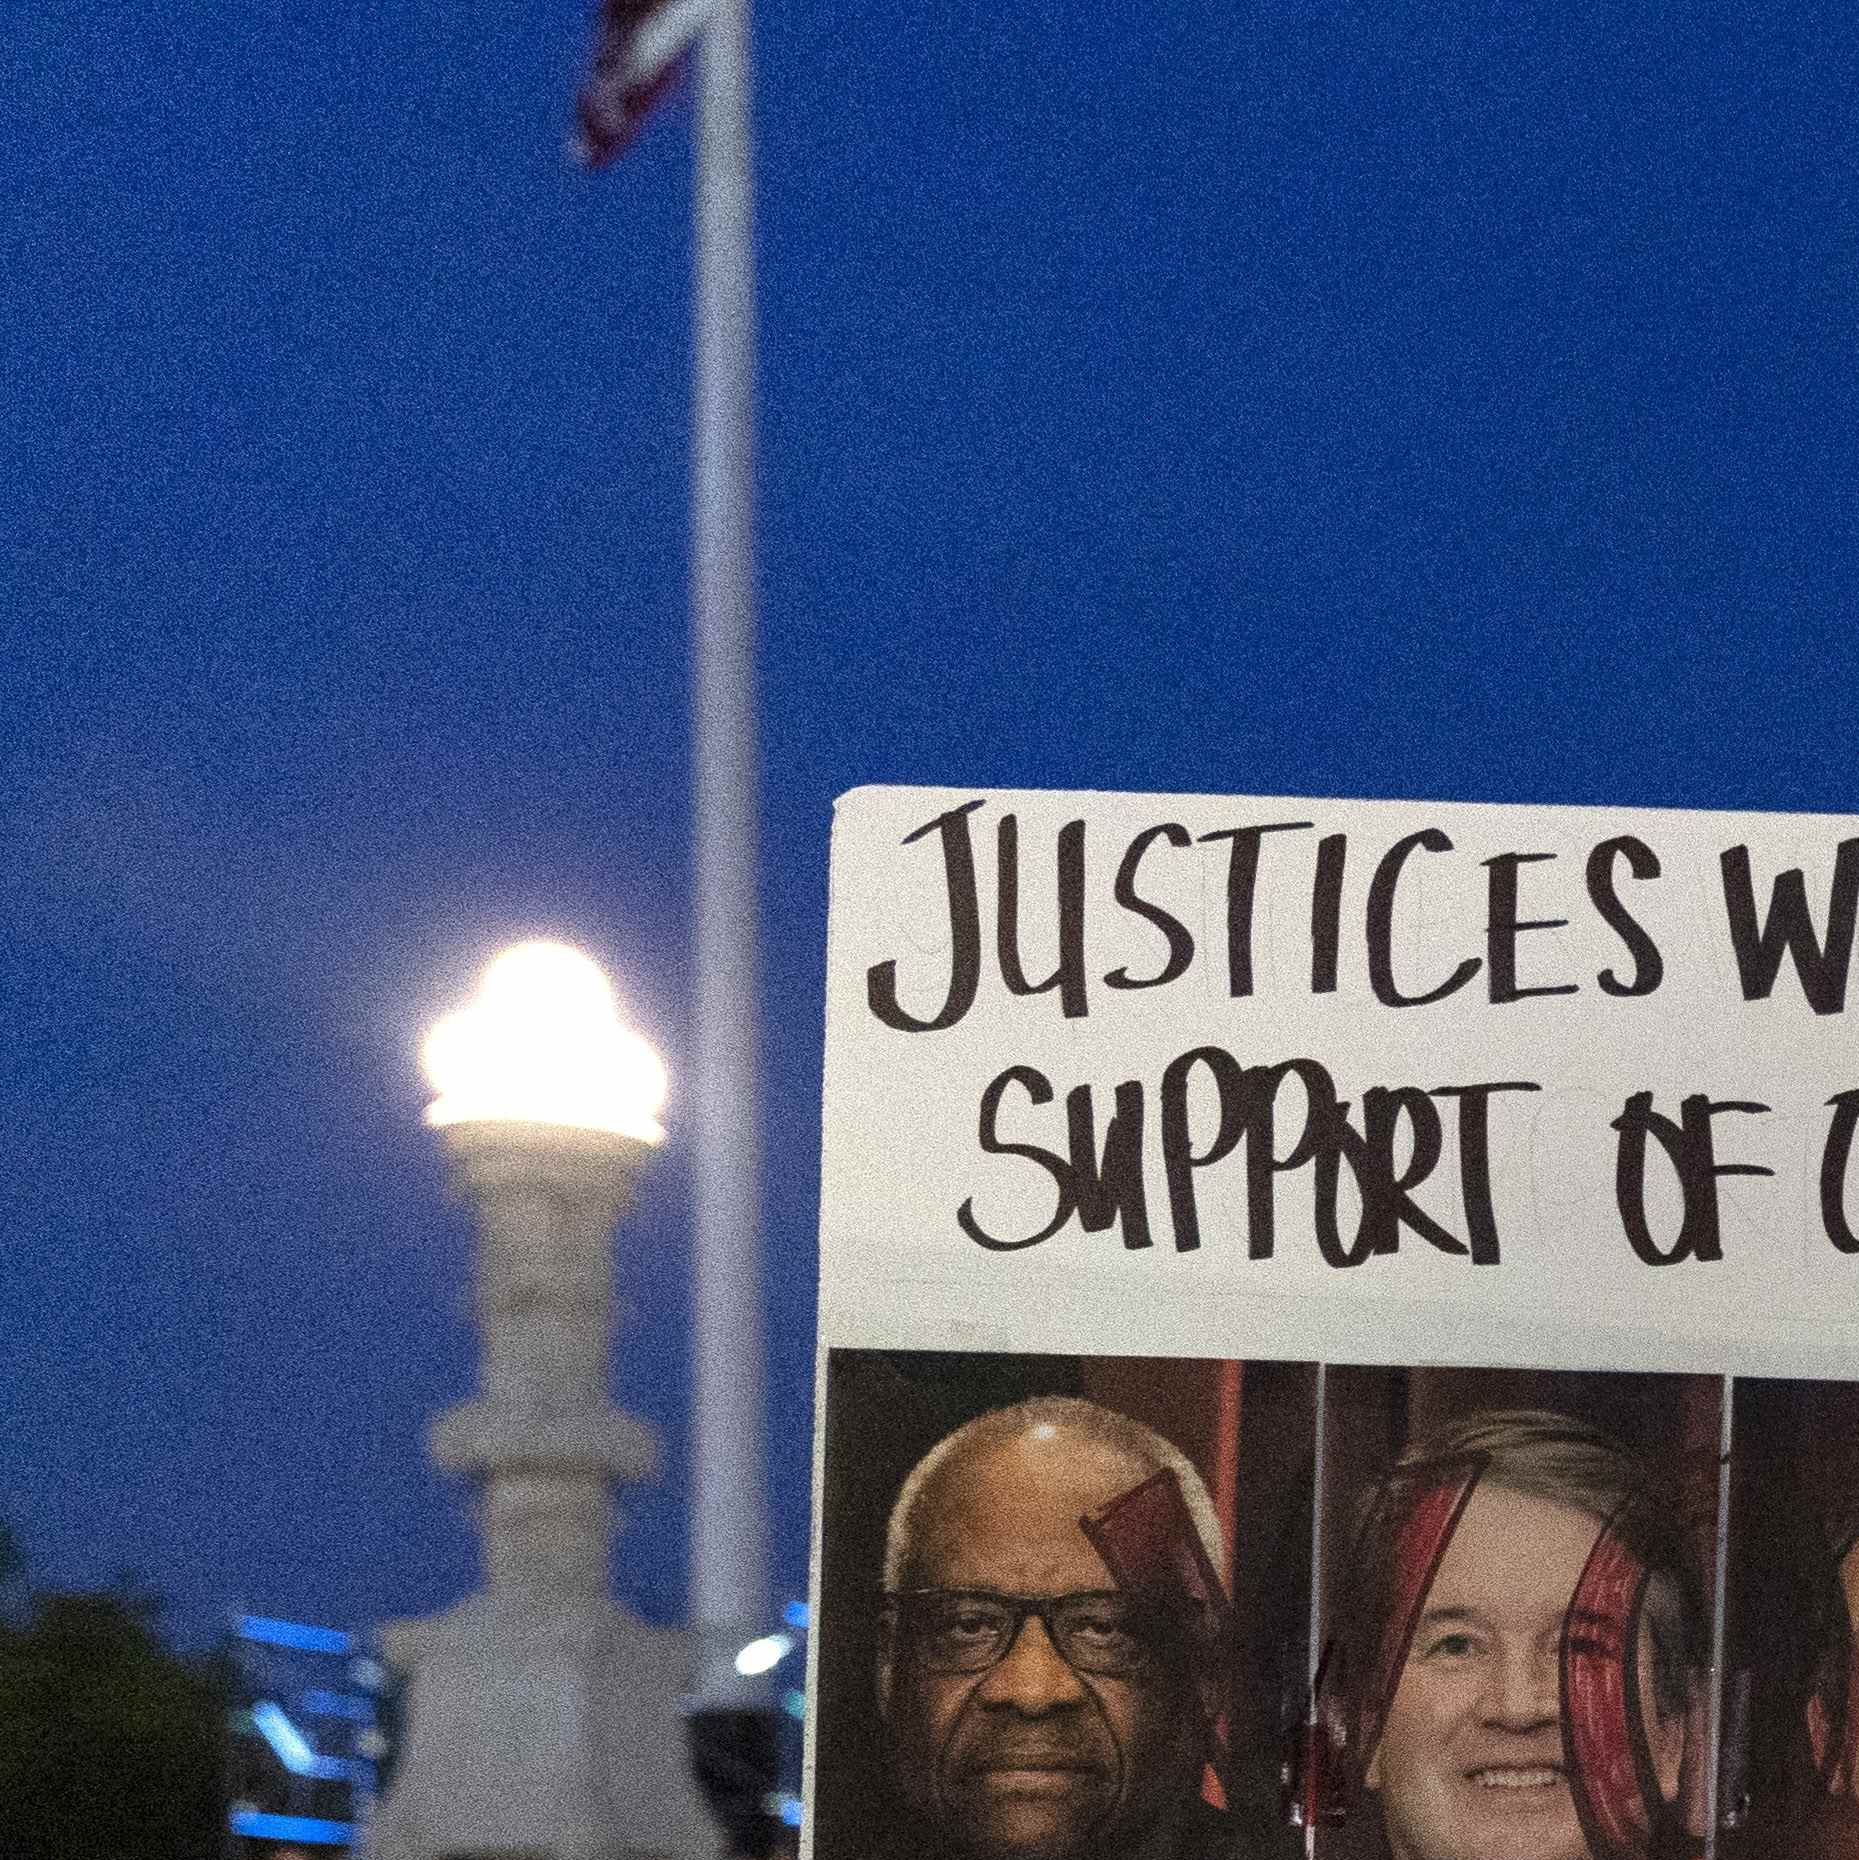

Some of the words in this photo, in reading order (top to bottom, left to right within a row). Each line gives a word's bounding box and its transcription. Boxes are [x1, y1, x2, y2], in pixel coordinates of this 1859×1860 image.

[870, 803, 1662, 1030] JUSTICES
[959, 1048, 1539, 1266] SUPPORT
[1612, 1092, 1772, 1265] OF
